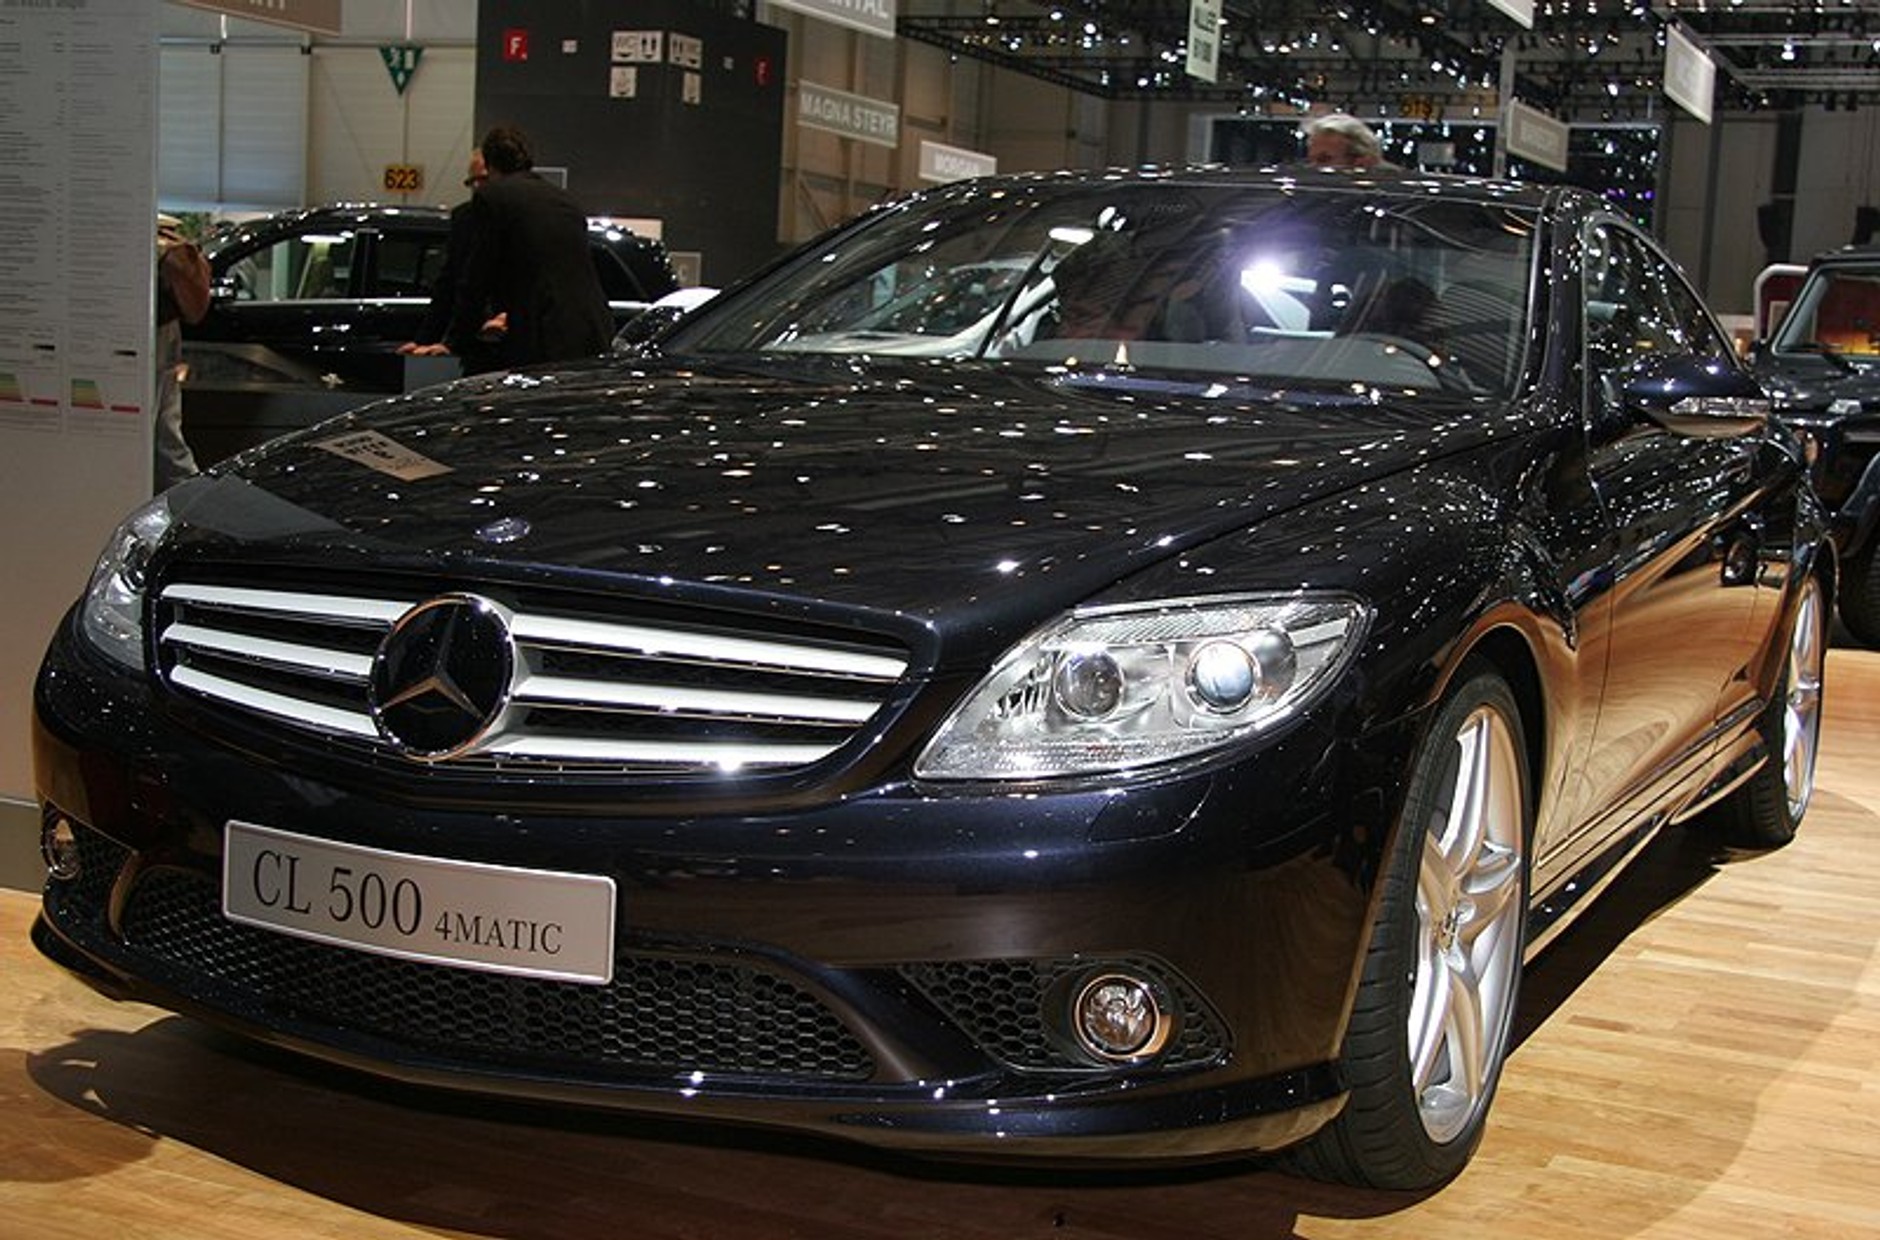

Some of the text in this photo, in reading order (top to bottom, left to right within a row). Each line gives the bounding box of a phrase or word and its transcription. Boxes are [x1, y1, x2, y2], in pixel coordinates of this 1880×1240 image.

[510, 37, 521, 54] F
[801, 92, 897, 136] MAGNA STEYR
[384, 168, 417, 190] 623
[253, 849, 563, 955] CL 500 4MATIC
